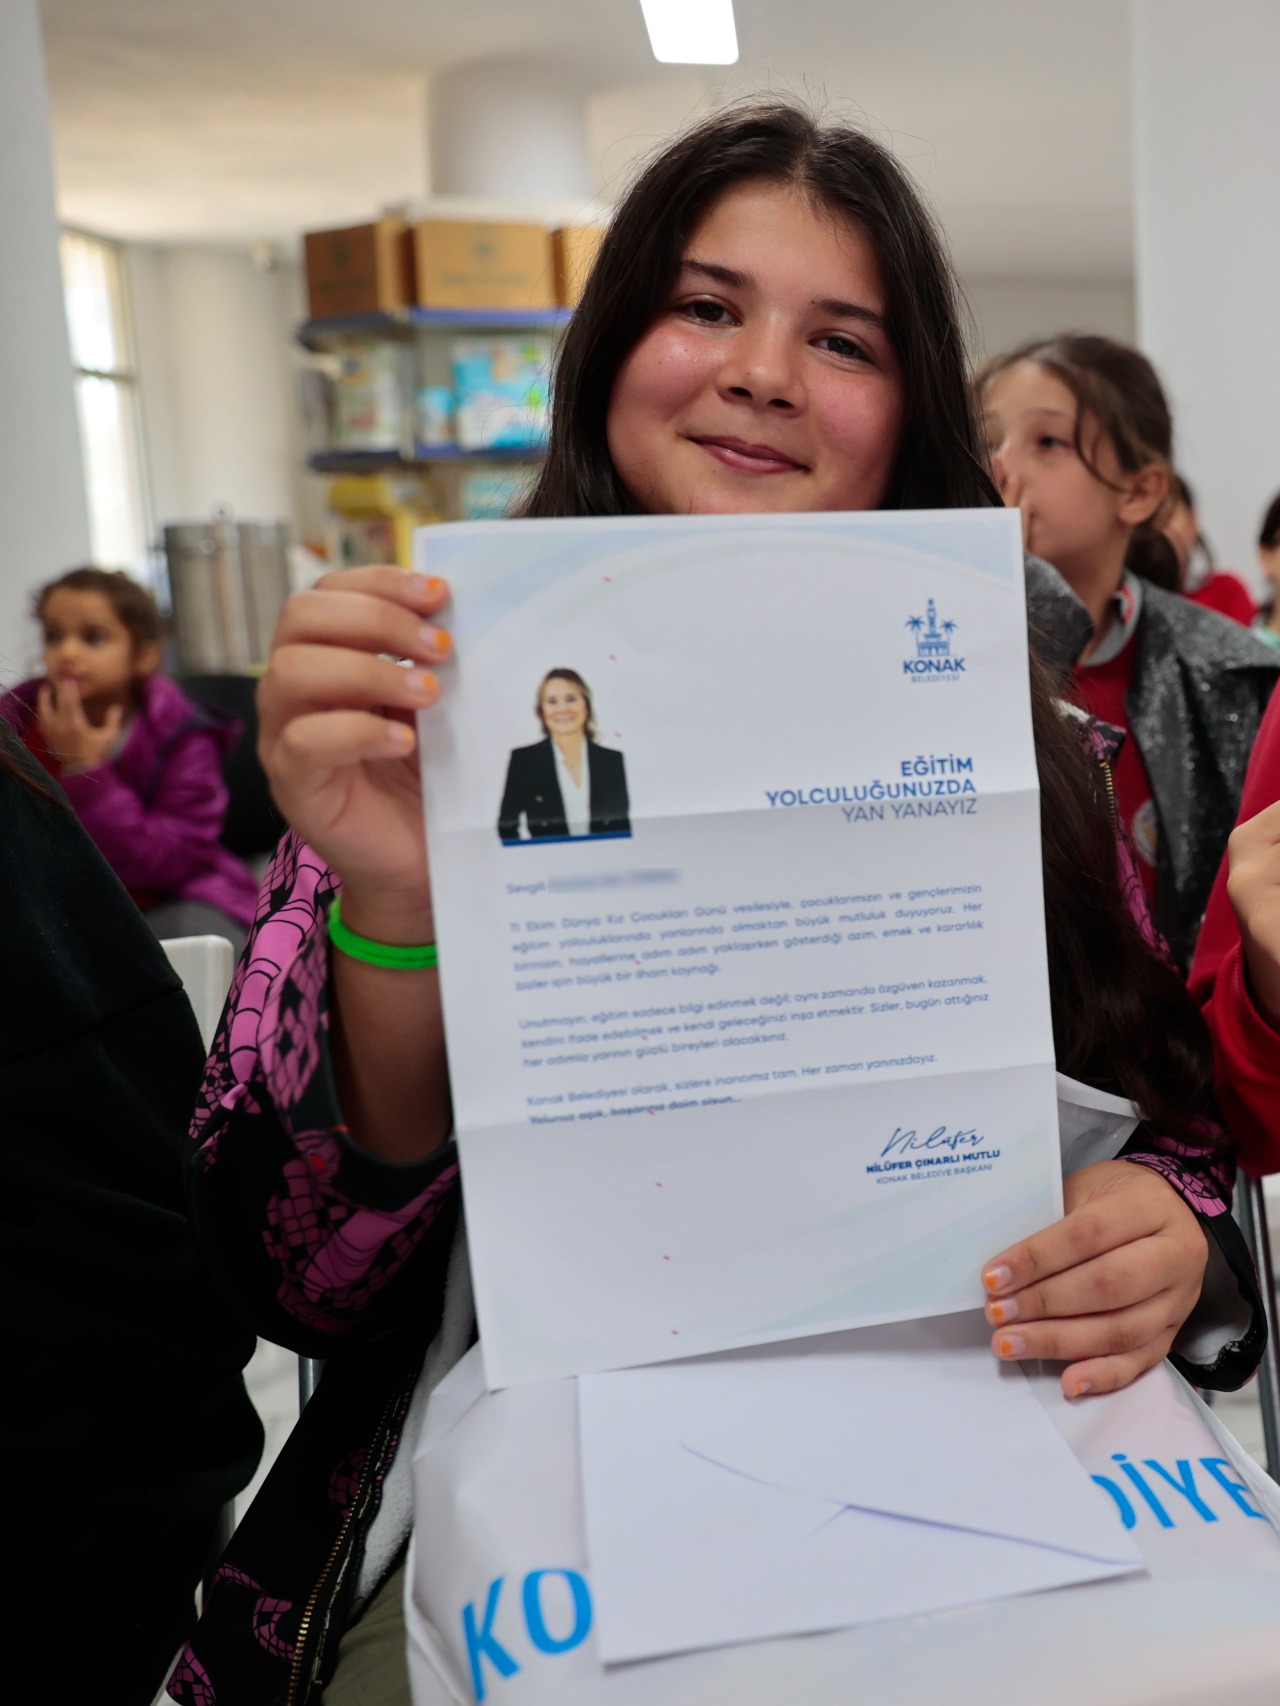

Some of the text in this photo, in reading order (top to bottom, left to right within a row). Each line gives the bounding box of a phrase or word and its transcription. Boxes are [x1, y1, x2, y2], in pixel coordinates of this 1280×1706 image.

[903, 657, 966, 674] KONAK
[901, 754, 973, 777] EĞİTİM
[765, 779, 976, 808] YOLCULUĞUNUZDA
[841, 798, 978, 823] YAN YANAYIZ
[799, 892, 883, 910] çocuklarımızın
[888, 891, 902, 901] ve
[907, 883, 982, 902] gençlerimizin
[795, 914, 831, 928] büyük
[838, 909, 887, 923] mutluluk
[962, 902, 983, 913] Her
[783, 931, 843, 950] gösterdiği
[882, 925, 913, 939] emek
[917, 925, 932, 935] ve
[936, 919, 984, 934] kararlılık
[793, 992, 819, 1004] aynı
[821, 985, 876, 1000] zamanda
[878, 981, 926, 996] özgüven
[789, 1011, 814, 1022] inşa
[905, 997, 942, 1011] bugün
[943, 992, 989, 1007] attığınız
[801, 1066, 822, 1077] Her
[824, 1062, 864, 1075] zaman
[866, 1148, 1001, 1175] NİLÜFER ÇINARLI MUTLU
